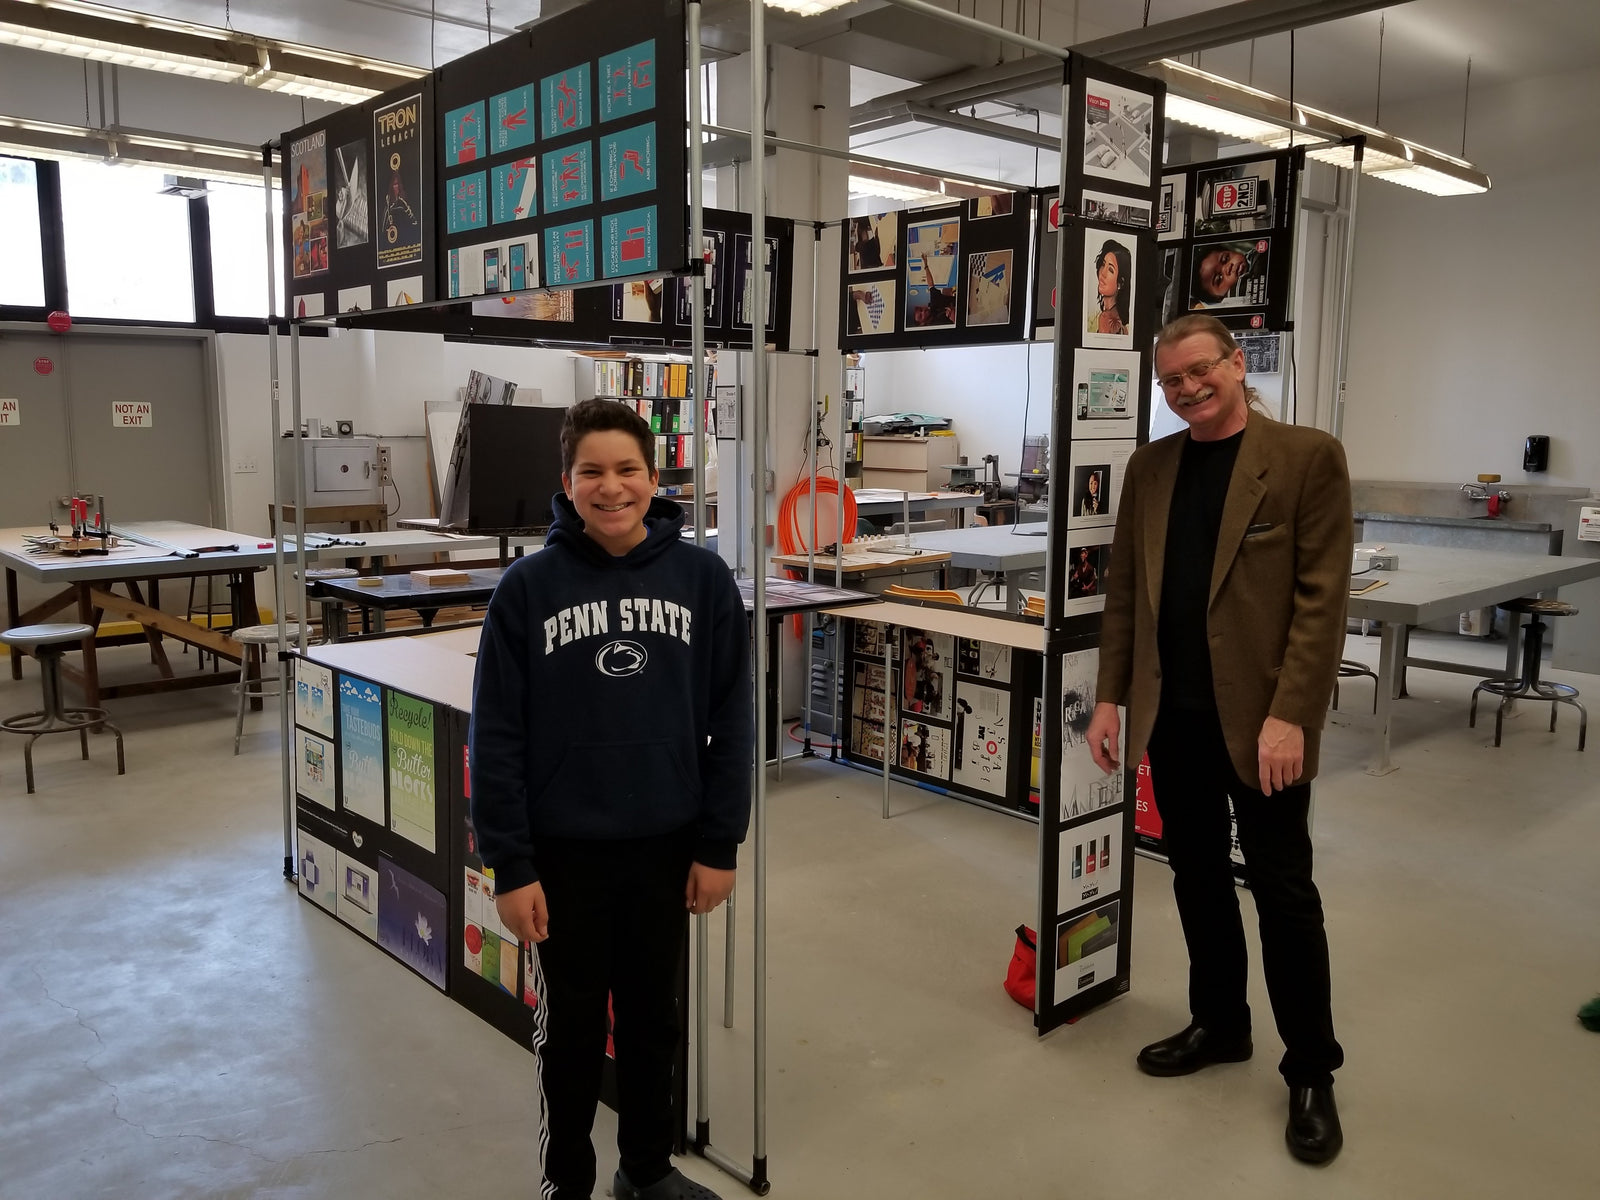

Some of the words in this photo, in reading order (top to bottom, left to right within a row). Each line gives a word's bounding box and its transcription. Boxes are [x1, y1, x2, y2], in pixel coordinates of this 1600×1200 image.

[378, 104, 416, 136] TRON
[291, 133, 325, 158] SCOTLAND
[380, 129, 415, 148] LEGACY
[1223, 186, 1232, 208] STOP
[1237, 183, 1250, 208] 2ND
[2, 402, 16, 411] AN
[115, 404, 134, 414] NOT
[136, 404, 150, 414] AN
[123, 416, 142, 425] EXIT
[544, 600, 609, 656] PENN
[620, 598, 692, 646] STATE
[389, 697, 432, 730] Recycle!
[346, 714, 380, 742] TASTEBUDS
[422, 740, 432, 758] THE
[396, 748, 432, 780] Butter
[392, 768, 432, 804] BLOCKS
